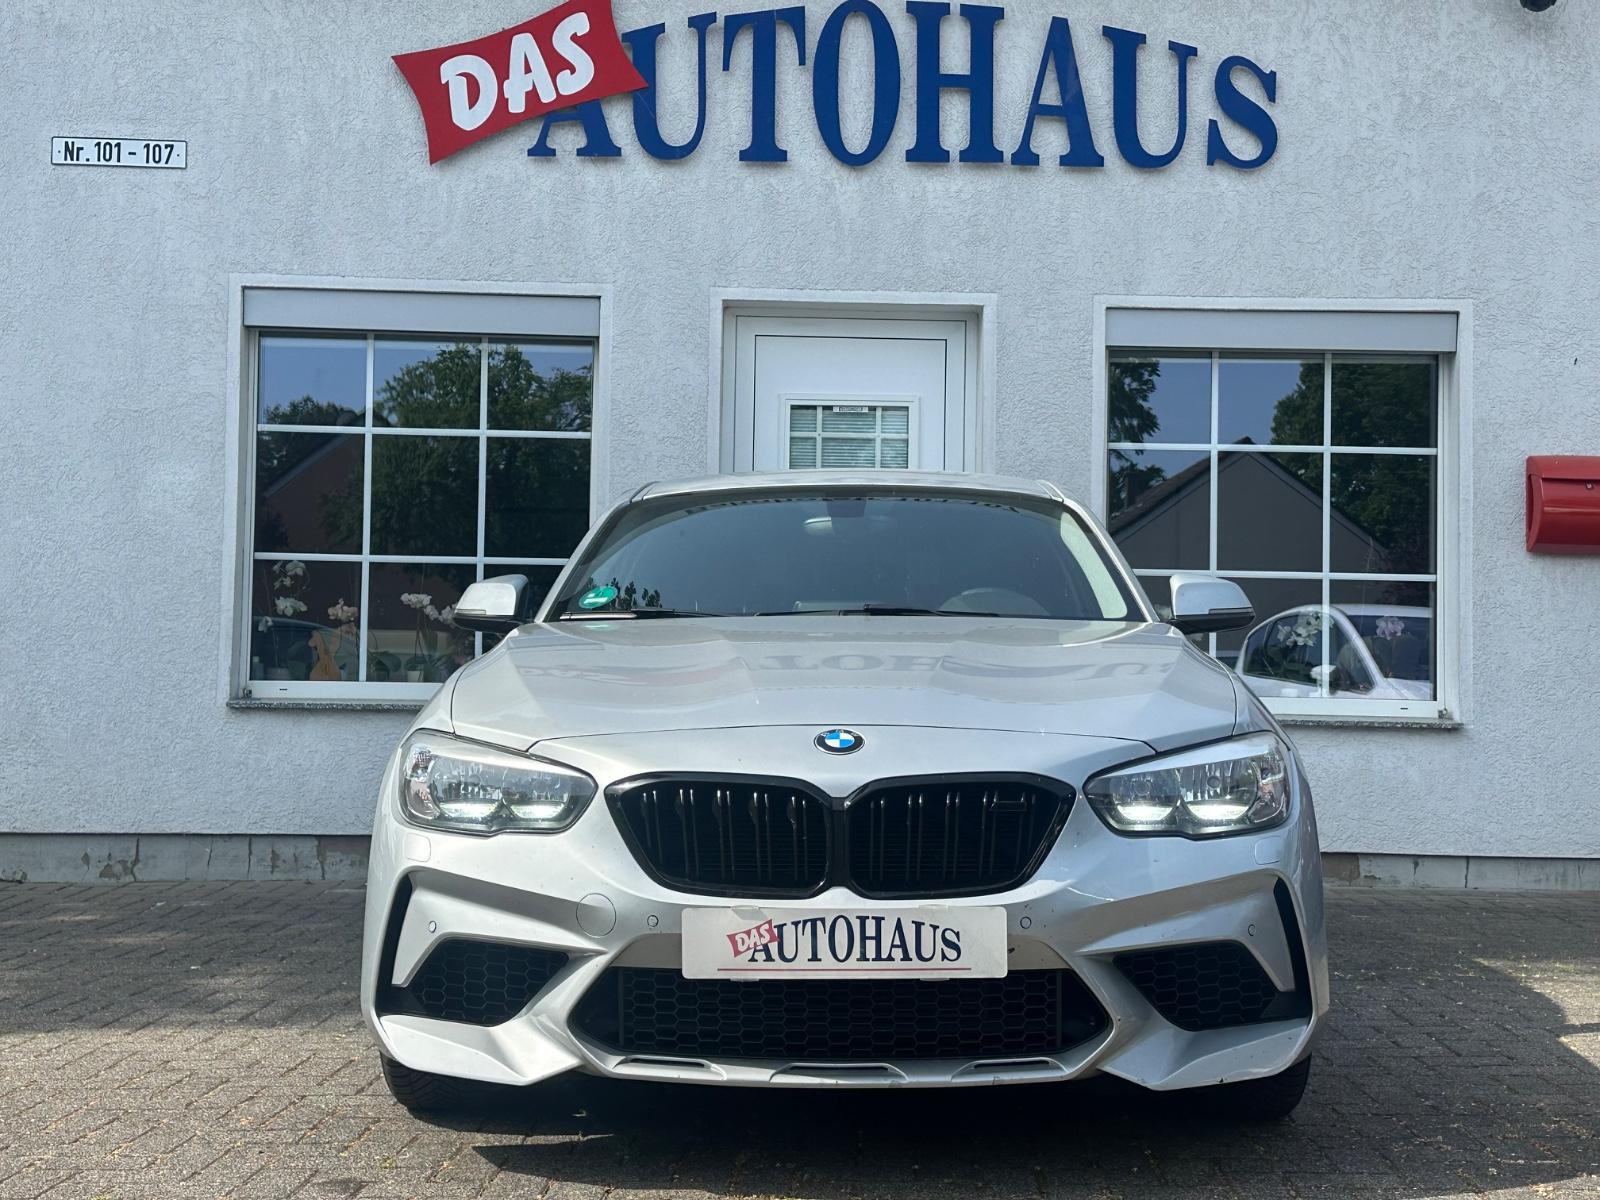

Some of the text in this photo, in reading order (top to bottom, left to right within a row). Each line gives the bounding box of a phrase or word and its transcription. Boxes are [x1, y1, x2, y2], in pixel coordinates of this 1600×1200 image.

[440, 0, 1278, 169] DAS AUTOHAUS
[735, 914, 963, 963] DAS AUTOHAUS
